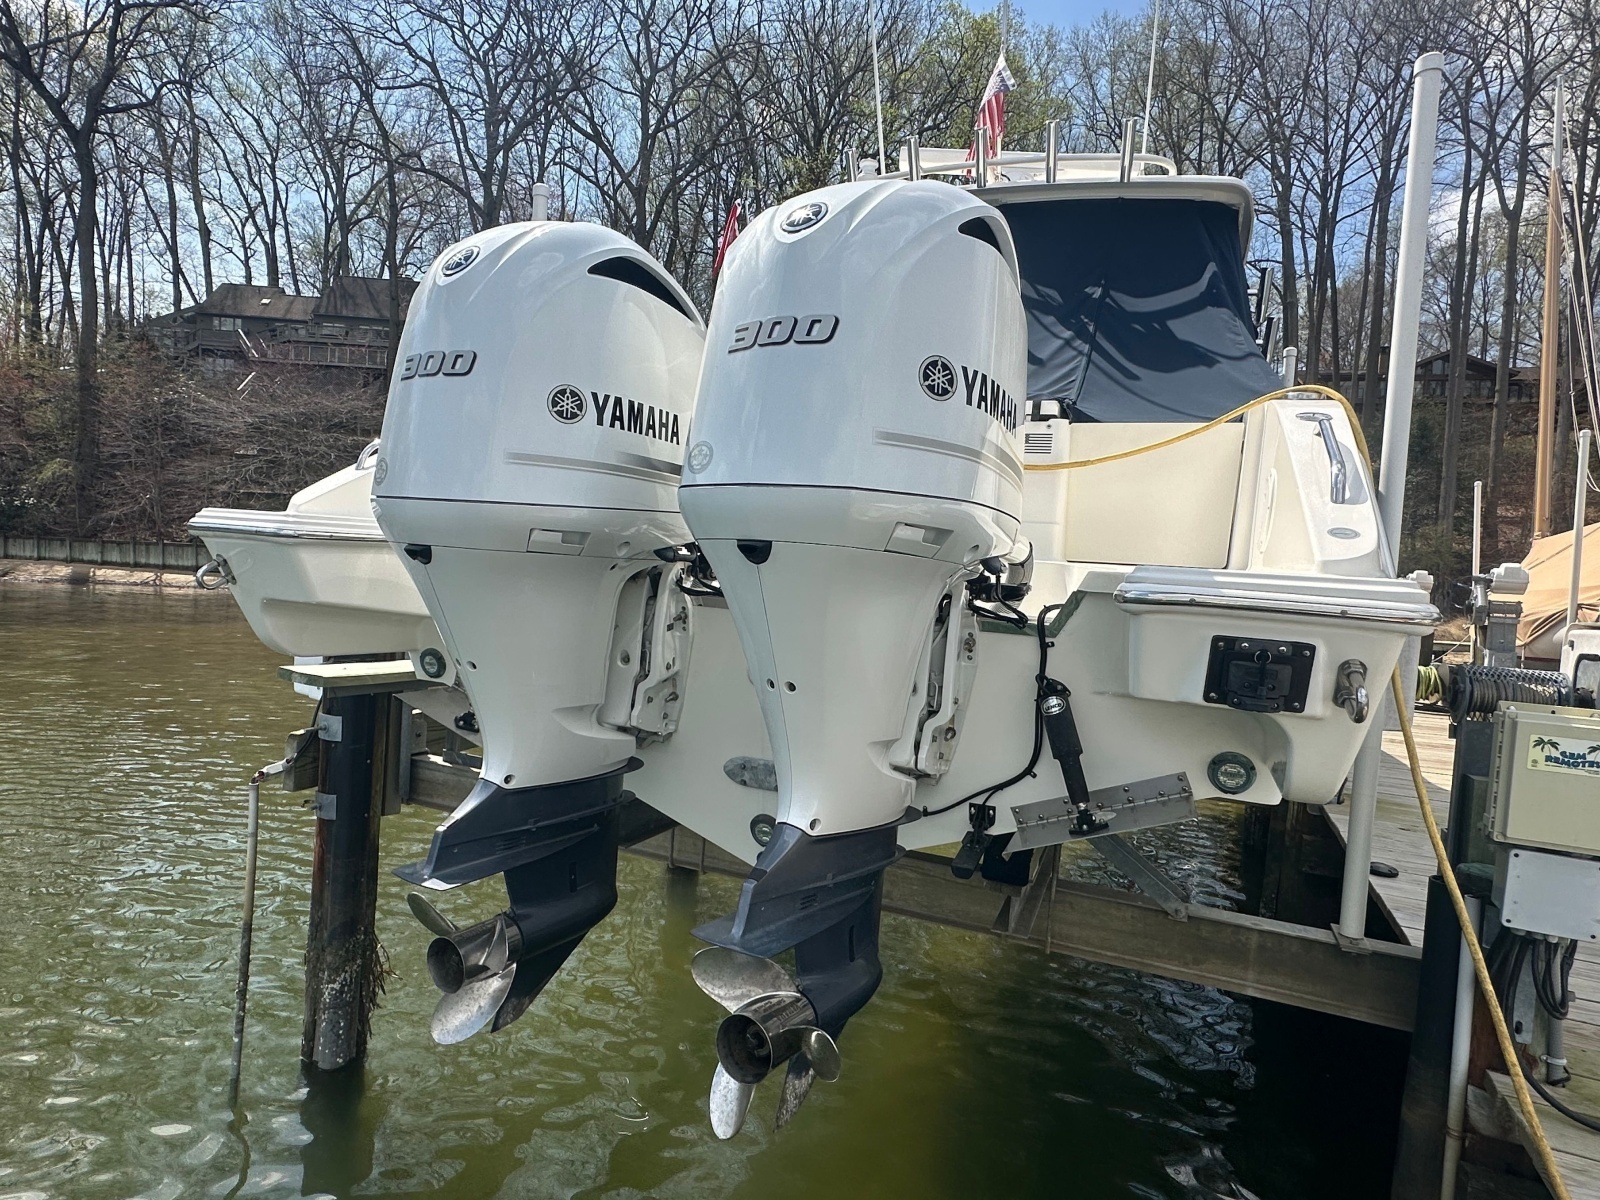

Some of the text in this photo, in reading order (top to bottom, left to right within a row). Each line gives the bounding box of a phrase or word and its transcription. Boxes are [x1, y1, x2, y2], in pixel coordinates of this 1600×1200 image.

[727, 314, 840, 354] 300
[400, 349, 478, 381] 300
[590, 391, 680, 446] YAMAHA
[961, 365, 1018, 439] YAMAHA
